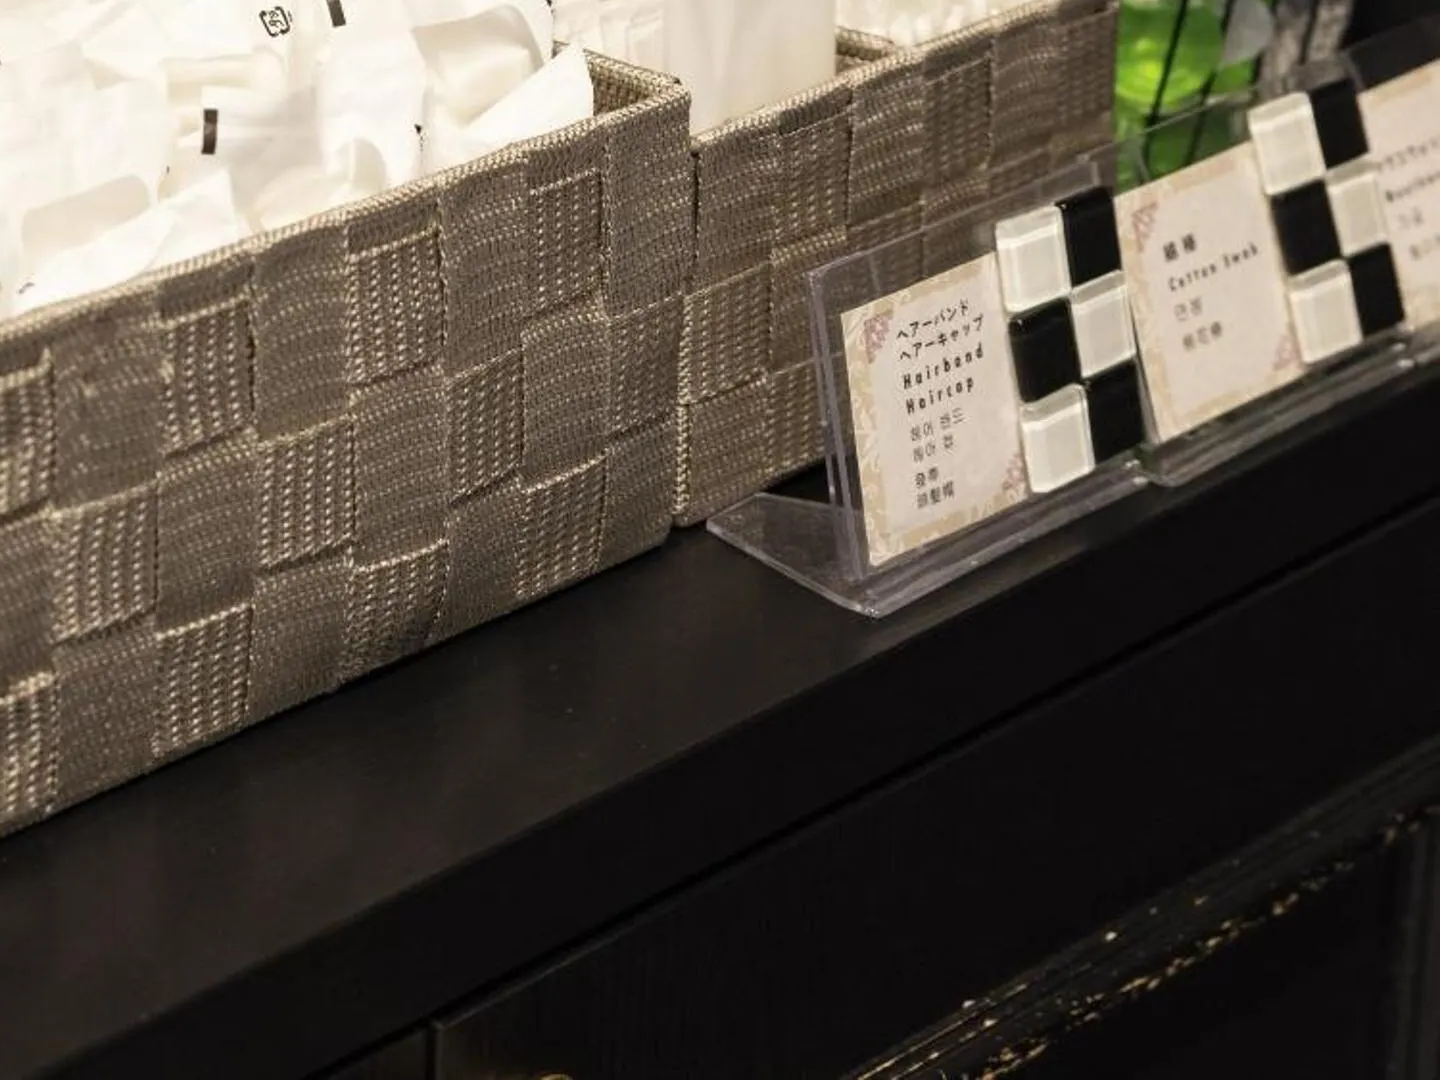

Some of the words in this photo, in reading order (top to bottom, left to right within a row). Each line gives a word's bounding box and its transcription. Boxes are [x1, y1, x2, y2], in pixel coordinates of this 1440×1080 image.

[897, 299, 968, 338] ヘアーバンド
[900, 314, 984, 360] ヘアーキャップ
[903, 342, 983, 389] Hairband
[906, 378, 973, 414] Haircap
